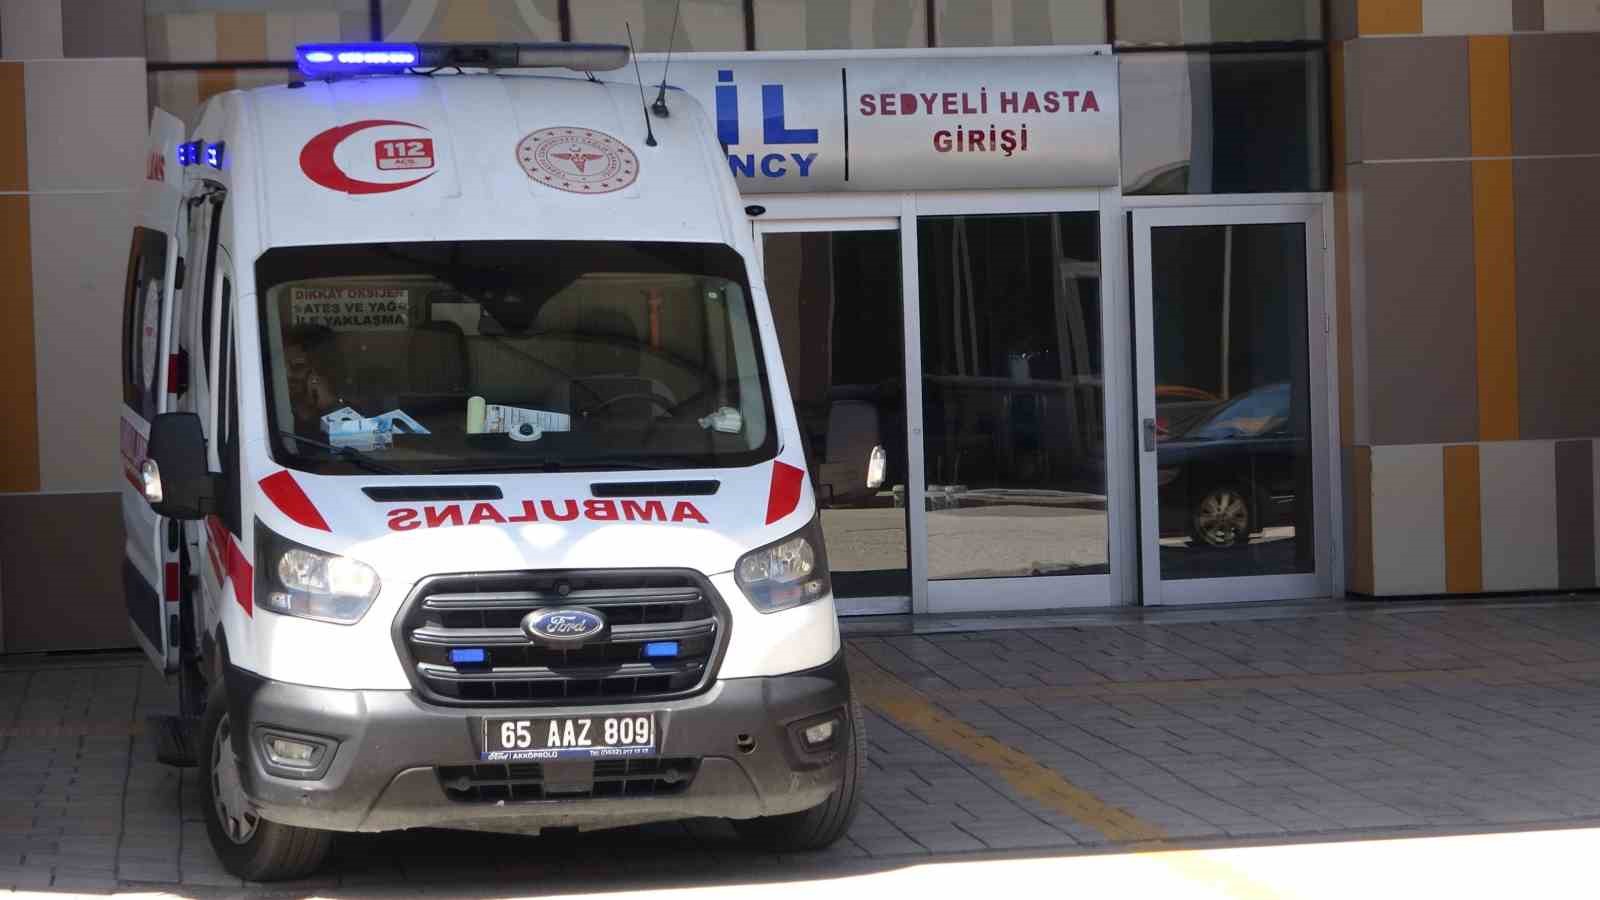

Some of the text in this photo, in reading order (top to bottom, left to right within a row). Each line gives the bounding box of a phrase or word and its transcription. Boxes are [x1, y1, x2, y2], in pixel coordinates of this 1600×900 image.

[859, 86, 1101, 116] SEDYELİ HASTA
[383, 141, 426, 157] 112
[932, 124, 1029, 157] GİRİŞİ
[344, 303, 366, 314] VE
[546, 616, 586, 633] Ford
[501, 717, 649, 748] 65 AAZ 809
